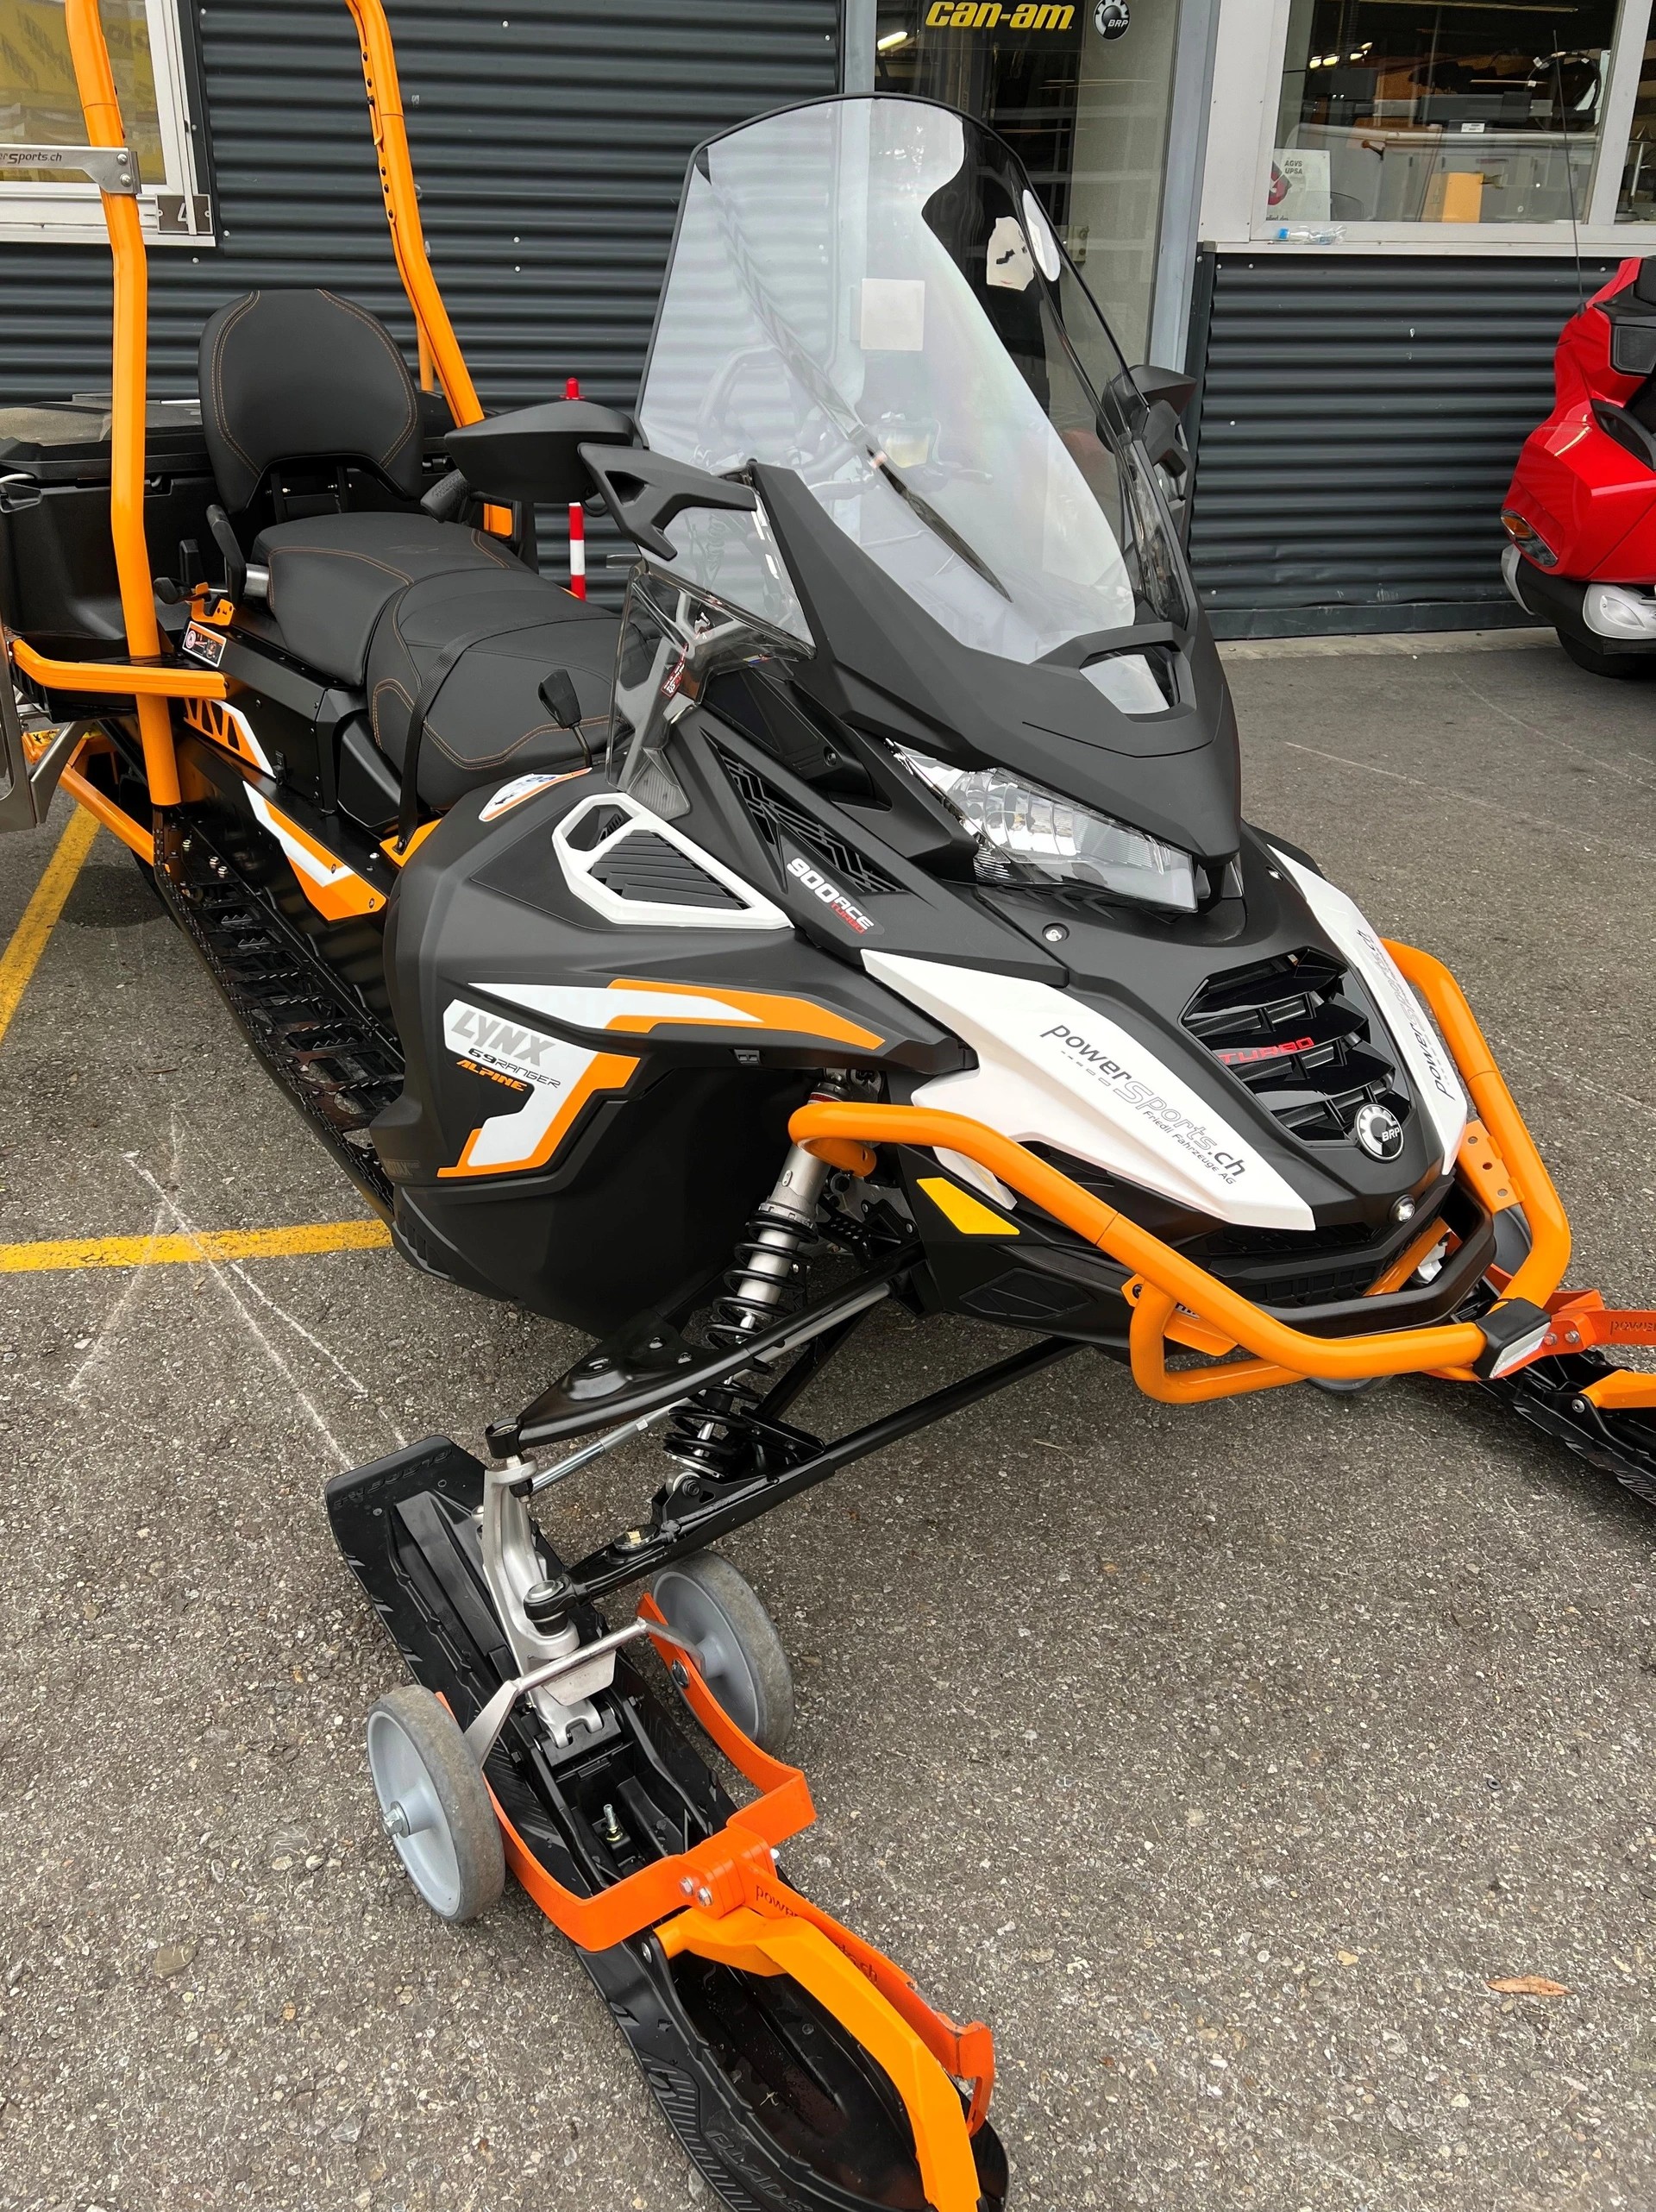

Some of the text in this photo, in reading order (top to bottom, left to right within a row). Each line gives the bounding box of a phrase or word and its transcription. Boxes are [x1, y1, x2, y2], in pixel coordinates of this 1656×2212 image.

[925, 1, 1076, 29] can-am
[1107, 19, 1129, 28] BRP
[831, 902, 865, 934] TURBO
[451, 1009, 556, 1066] LYNX
[1218, 1037, 1314, 1065] TURBO
[456, 1059, 528, 1091] ALPINE
[1382, 1128, 1401, 1142] BRP
[1218, 1172, 1237, 1185] AG
